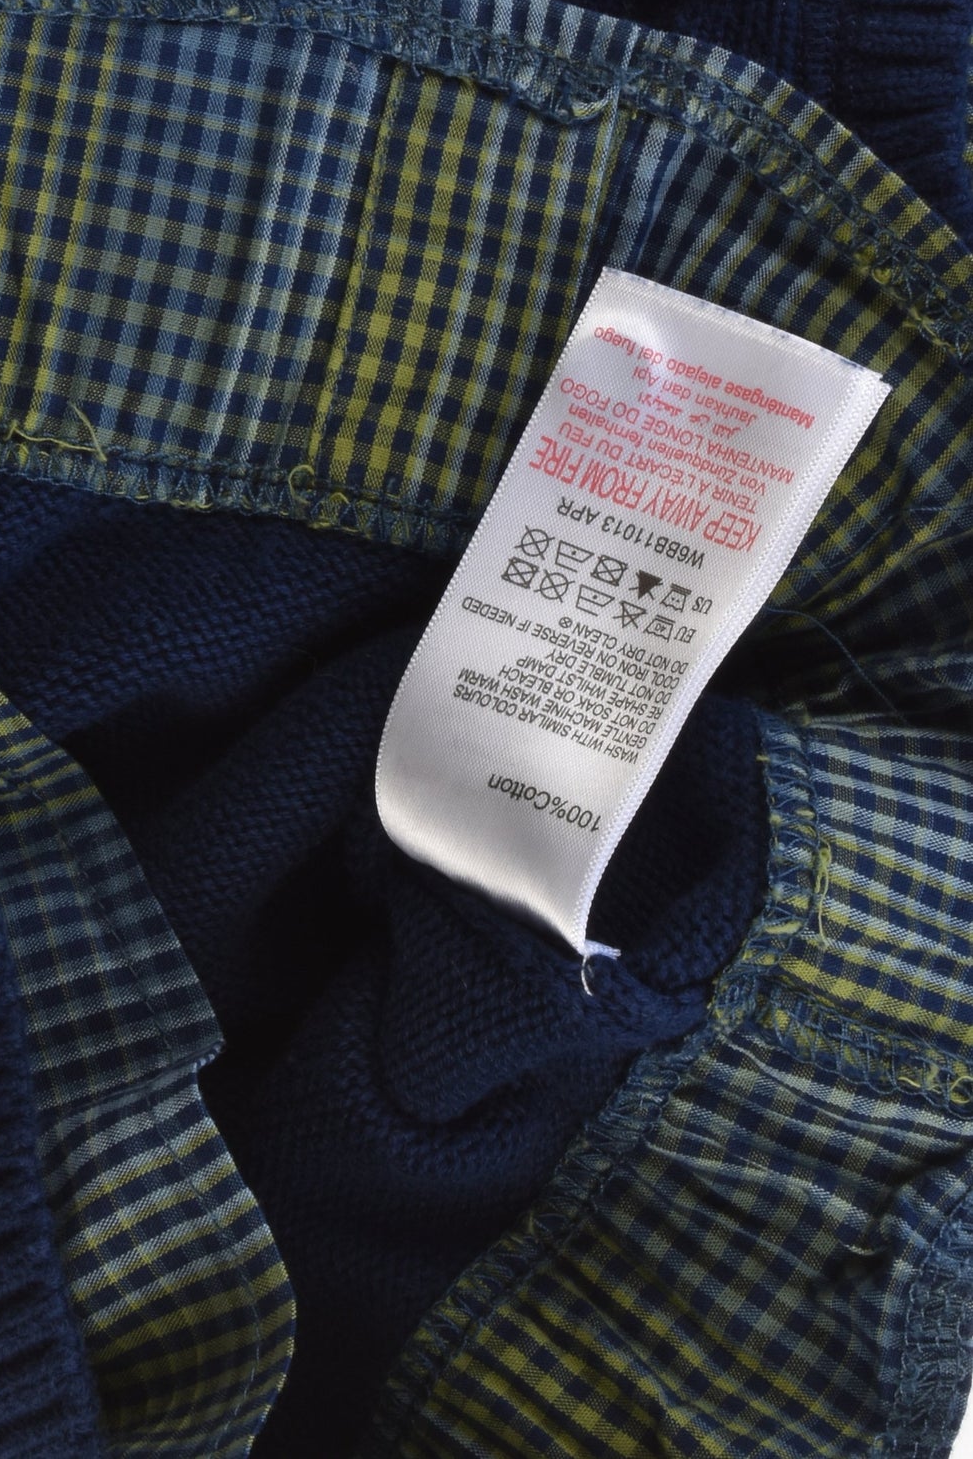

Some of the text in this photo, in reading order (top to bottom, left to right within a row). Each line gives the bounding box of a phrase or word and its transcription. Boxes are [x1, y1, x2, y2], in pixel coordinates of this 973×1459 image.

[591, 322, 816, 429] Manténgase alejado del fuego
[629, 363, 758, 428] Jauhkan dari Api
[557, 420, 594, 448] FEU
[558, 376, 795, 484] MANTENHA LONGE DO FOGO
[565, 402, 768, 496] Von Zündquellen fernhalten
[594, 437, 623, 461] DU
[527, 434, 762, 554] KEEP AWAY FROM FIRE
[710, 484, 758, 513] TENIR
[554, 496, 705, 569] W6BB11013 APR
[672, 625, 697, 644] EU
[690, 595, 713, 614] US
[460, 594, 680, 689] COOL IRON ON REVERSE IF NEEDED
[571, 621, 689, 675] DO NOT DRY CLEAN
[457, 666, 648, 750] GENTLE MACHINE WASH WARM
[497, 663, 656, 735] DO NOT SOAK OR BLEACH
[514, 654, 664, 720] RE SHAPE WHILST DAMP
[544, 647, 672, 705] DO NOT TUMBLE DRY
[451, 682, 638, 765] WASH WITH SIMILAR COLOURS
[486, 772, 601, 833] 100%Cotton
